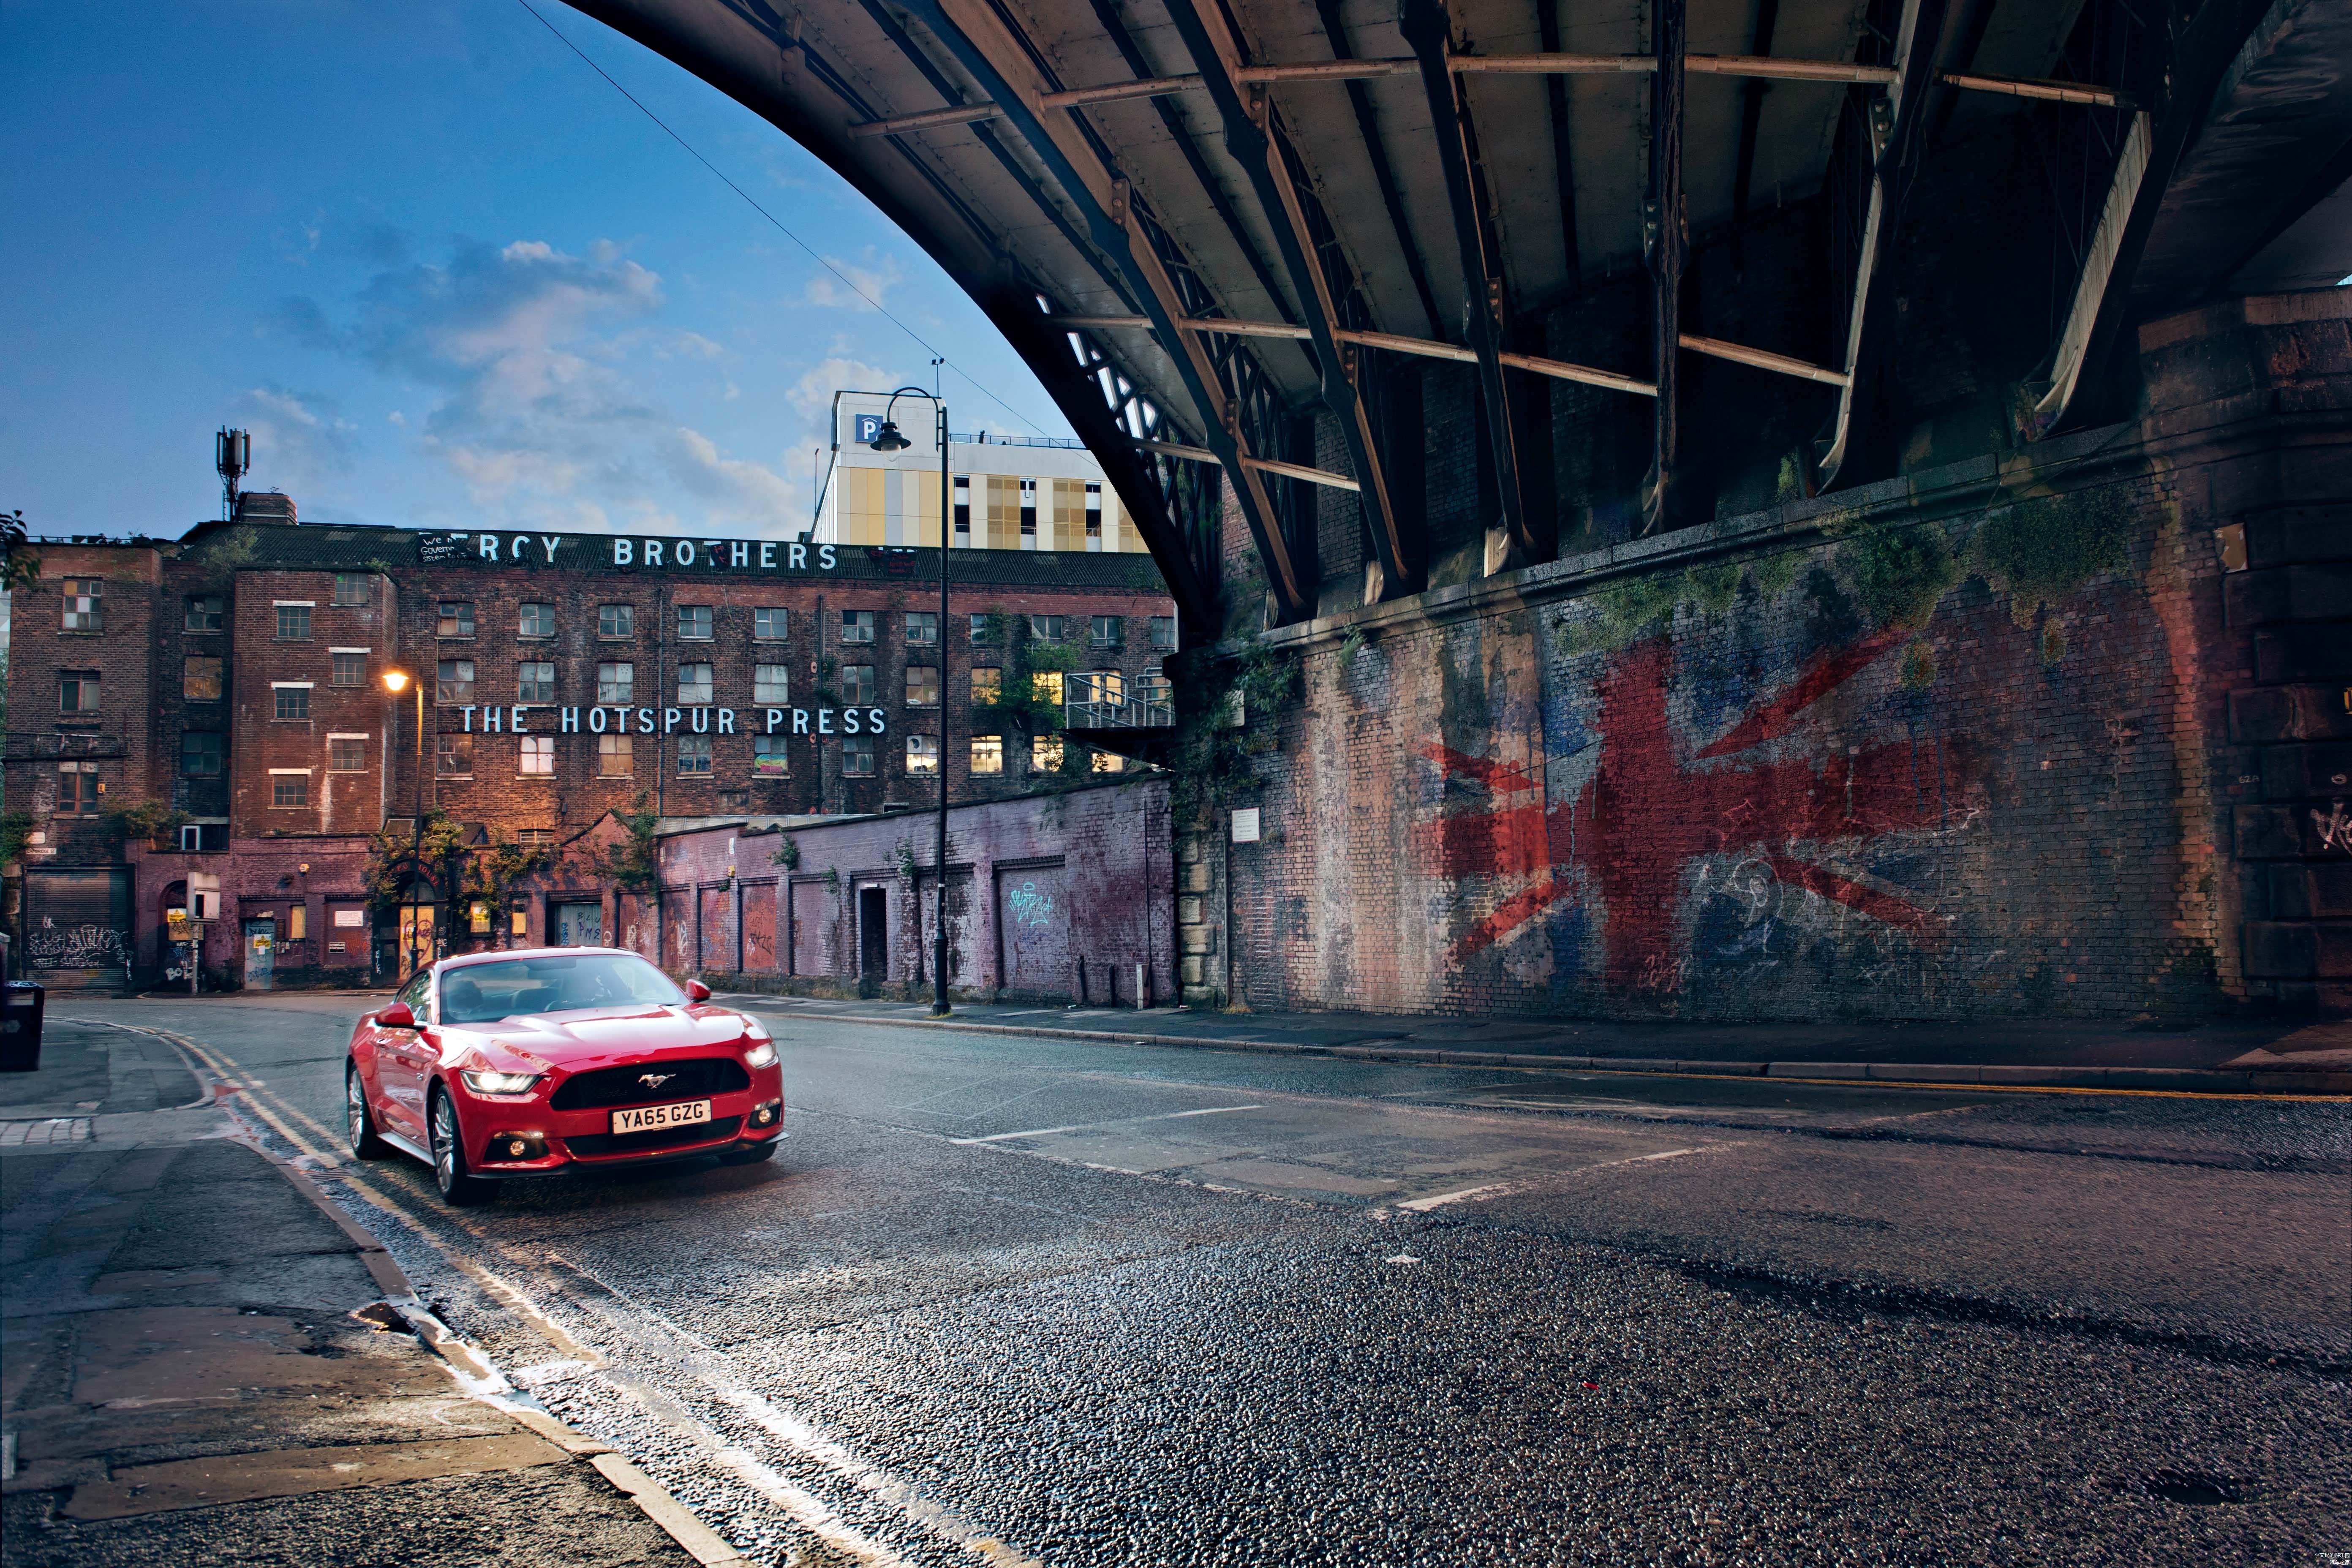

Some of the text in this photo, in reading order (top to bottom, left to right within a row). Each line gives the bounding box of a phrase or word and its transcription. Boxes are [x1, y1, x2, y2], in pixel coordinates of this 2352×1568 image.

[864, 421, 876, 439] P
[418, 532, 561, 563] RCY
[614, 539, 836, 569] BROTHERS
[460, 706, 885, 734] THE HOTSPUR PRESS
[2238, 775, 2260, 783] 62A
[621, 1103, 703, 1128] YA65 GZG
